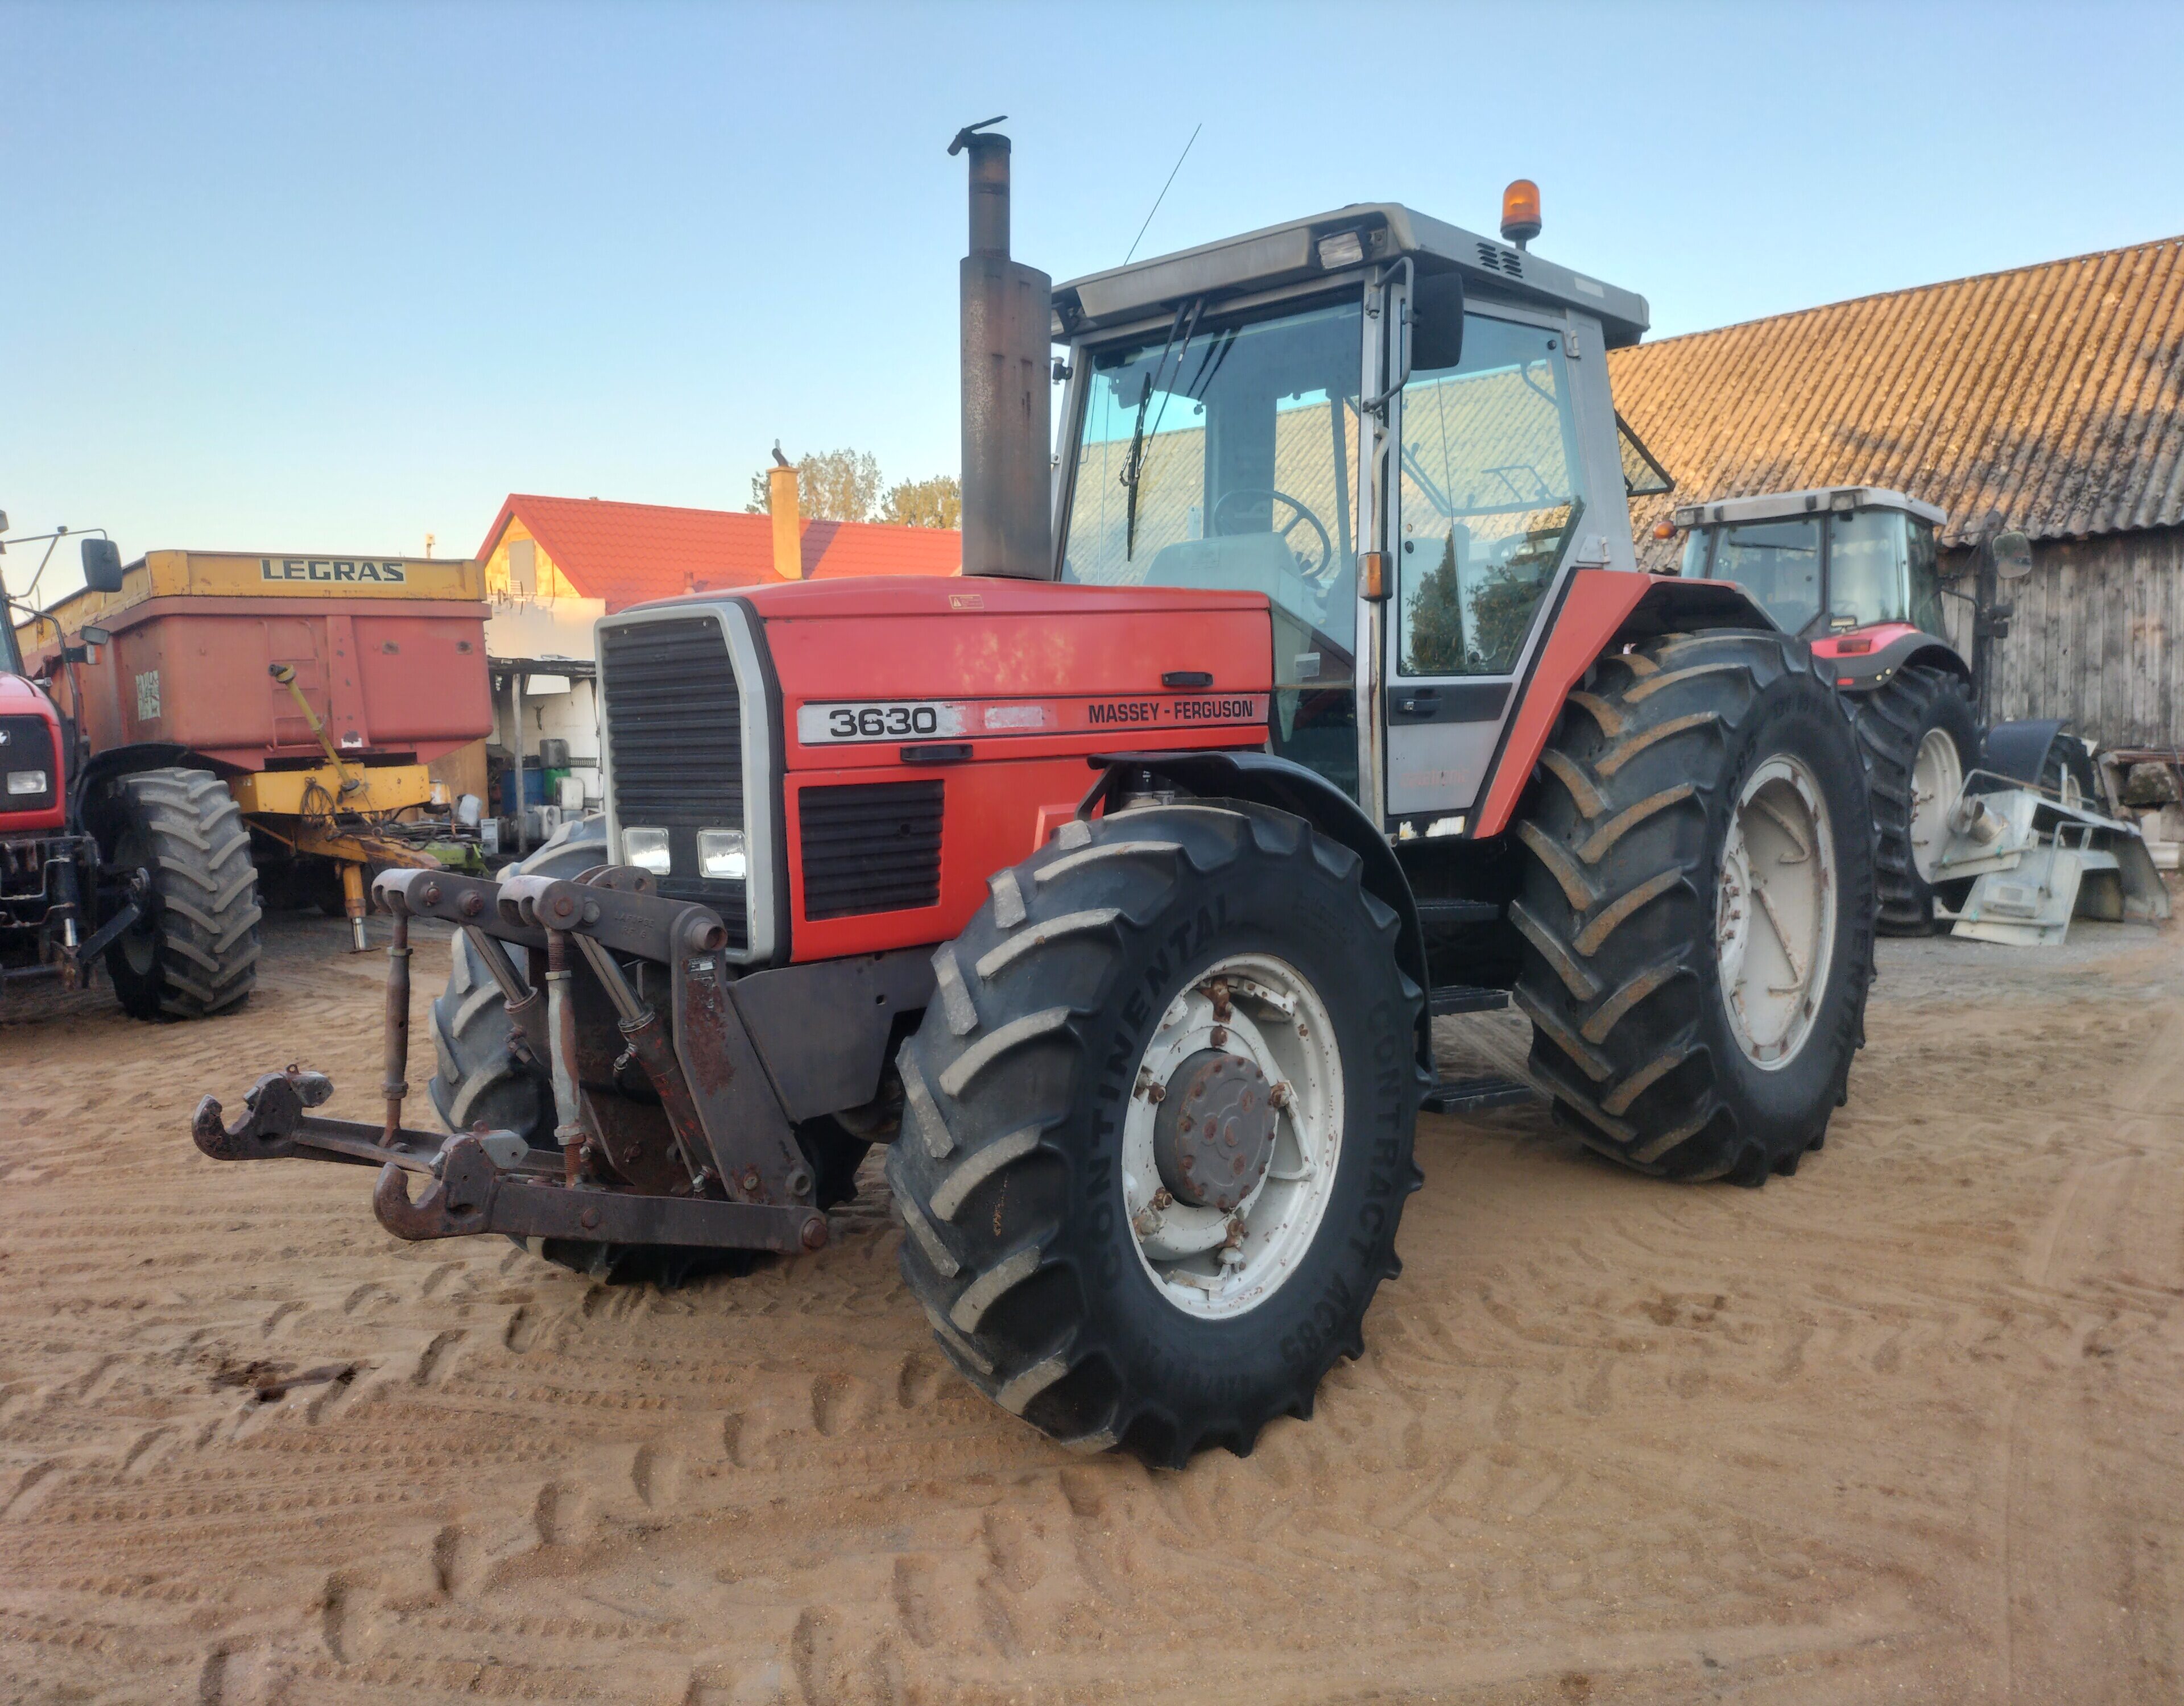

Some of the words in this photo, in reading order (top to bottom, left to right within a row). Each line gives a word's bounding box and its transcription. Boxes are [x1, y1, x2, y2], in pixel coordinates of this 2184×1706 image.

[262, 559, 404, 582] LEGRAS
[829, 707, 937, 737] 3630
[1088, 703, 1160, 723] MASSEY
[1174, 700, 1253, 720] FERGUSON
[1087, 892, 1235, 1290] CONTINENTAL
[1349, 999, 1401, 1267] CONTRACT
[1280, 1272, 1351, 1365] AC85
